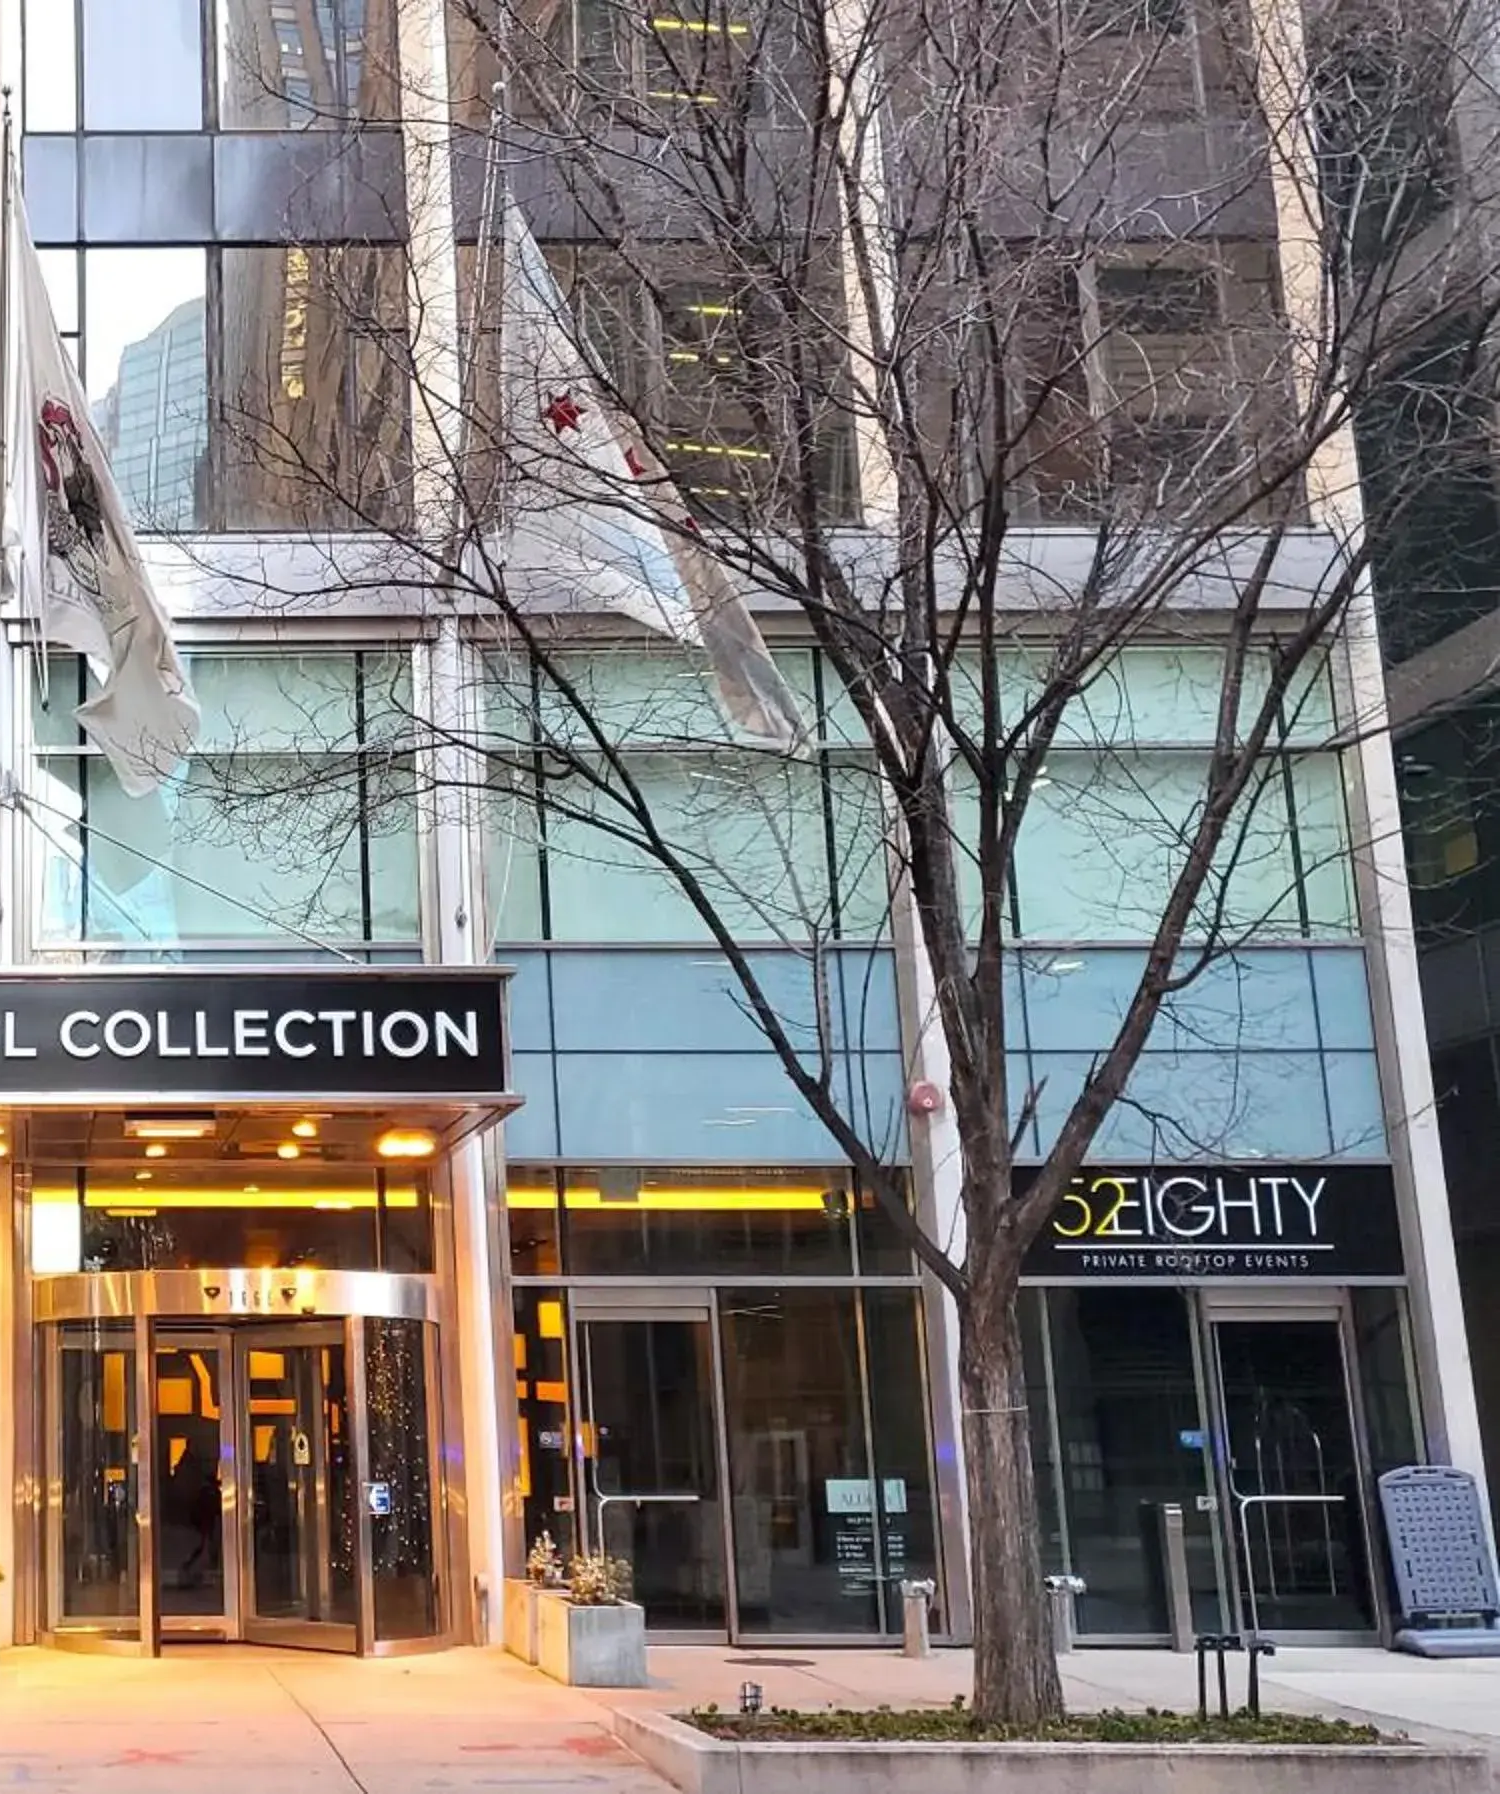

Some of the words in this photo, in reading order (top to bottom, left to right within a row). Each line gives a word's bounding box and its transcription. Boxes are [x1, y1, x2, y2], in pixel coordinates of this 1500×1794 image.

[59, 1010, 479, 1058] COLLECTION
[1083, 1254, 1148, 1268] PRIVATE
[1155, 1254, 1236, 1268] ROOFTOP
[1244, 1254, 1309, 1268] EVENTS
